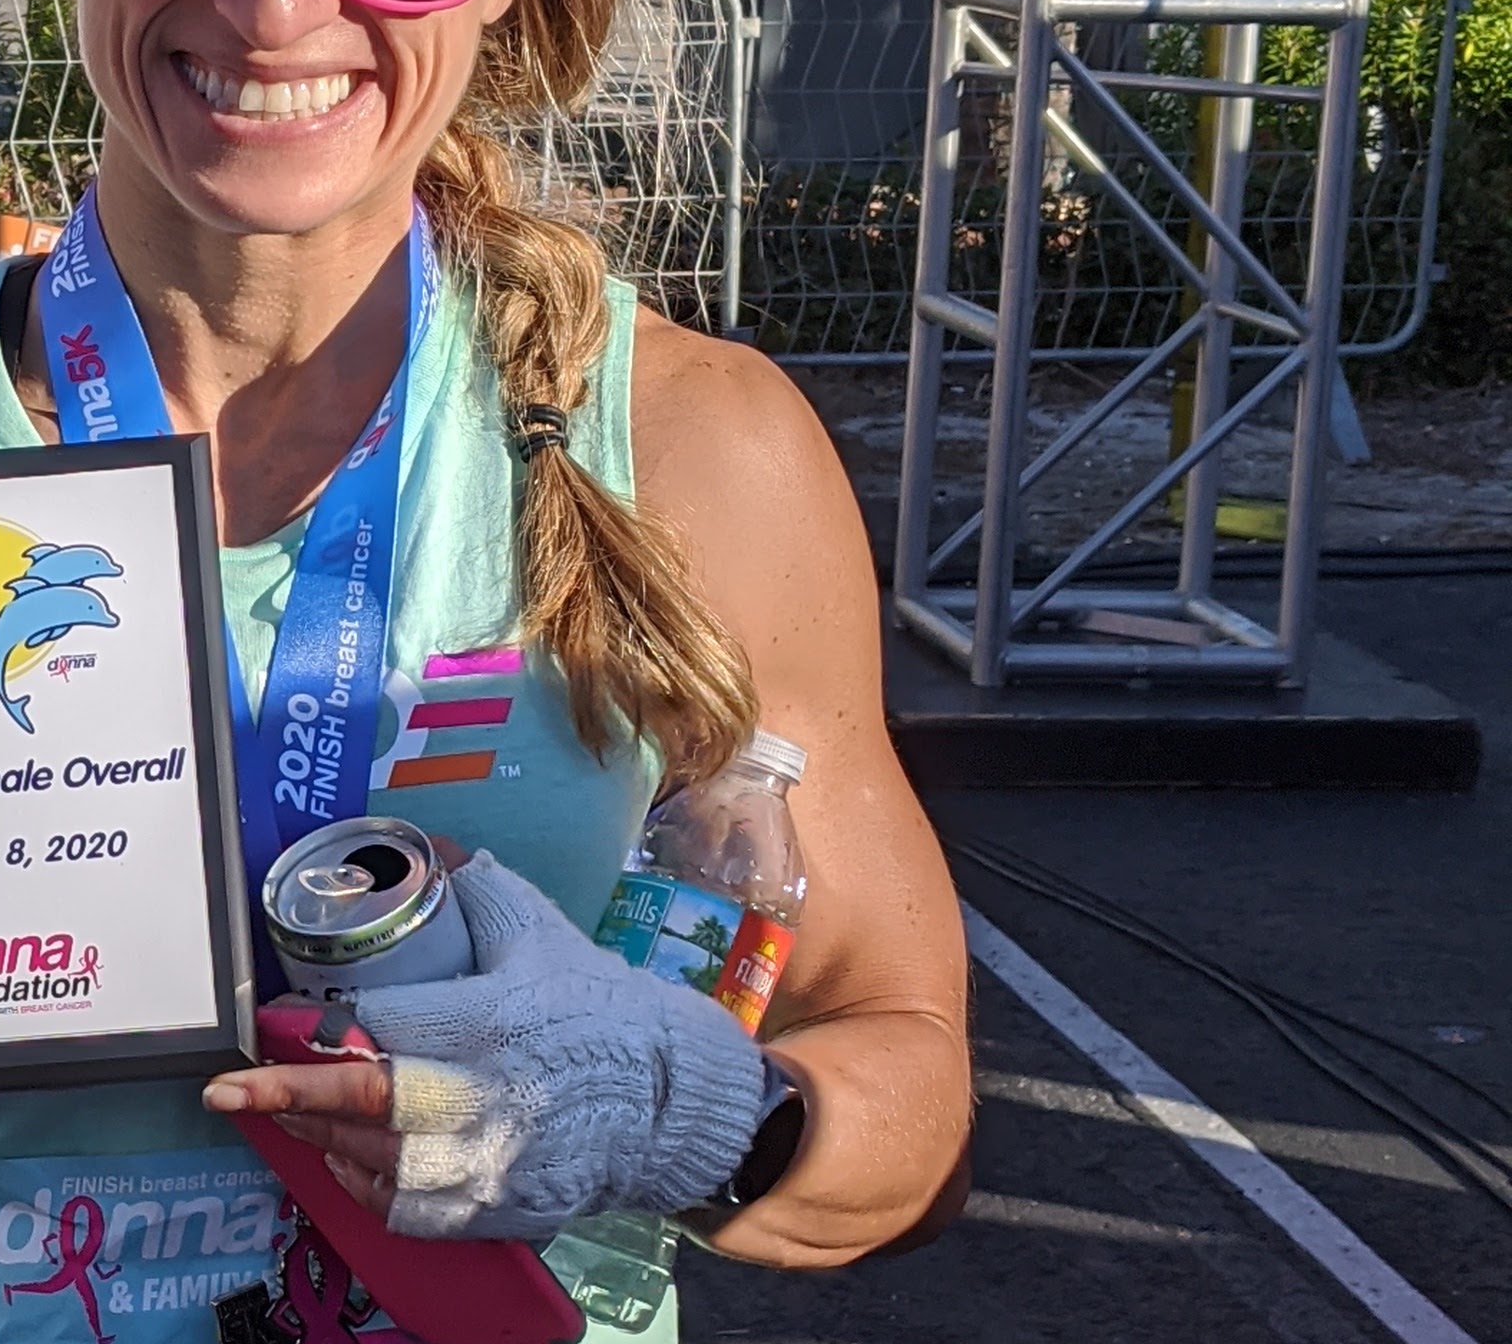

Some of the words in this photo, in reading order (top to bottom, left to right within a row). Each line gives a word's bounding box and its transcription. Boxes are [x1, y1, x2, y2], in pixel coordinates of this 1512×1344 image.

[69, 204, 97, 288] FINISH
[344, 518, 374, 612] cancer
[330, 619, 360, 707] breast
[62, 747, 187, 788] Overall
[275, 693, 319, 813] 2020
[311, 715, 346, 819] FINISH
[497, 764, 521, 778] TM
[5, 839, 31, 869] 8,
[45, 830, 129, 863] 2020
[20, 1004, 53, 1014] BREAST
[55, 1001, 93, 1011] CANCER
[62, 1176, 134, 1195] FINISH
[141, 1173, 207, 1193] breast
[214, 1170, 280, 1188] cance
[109, 1280, 133, 1313] &
